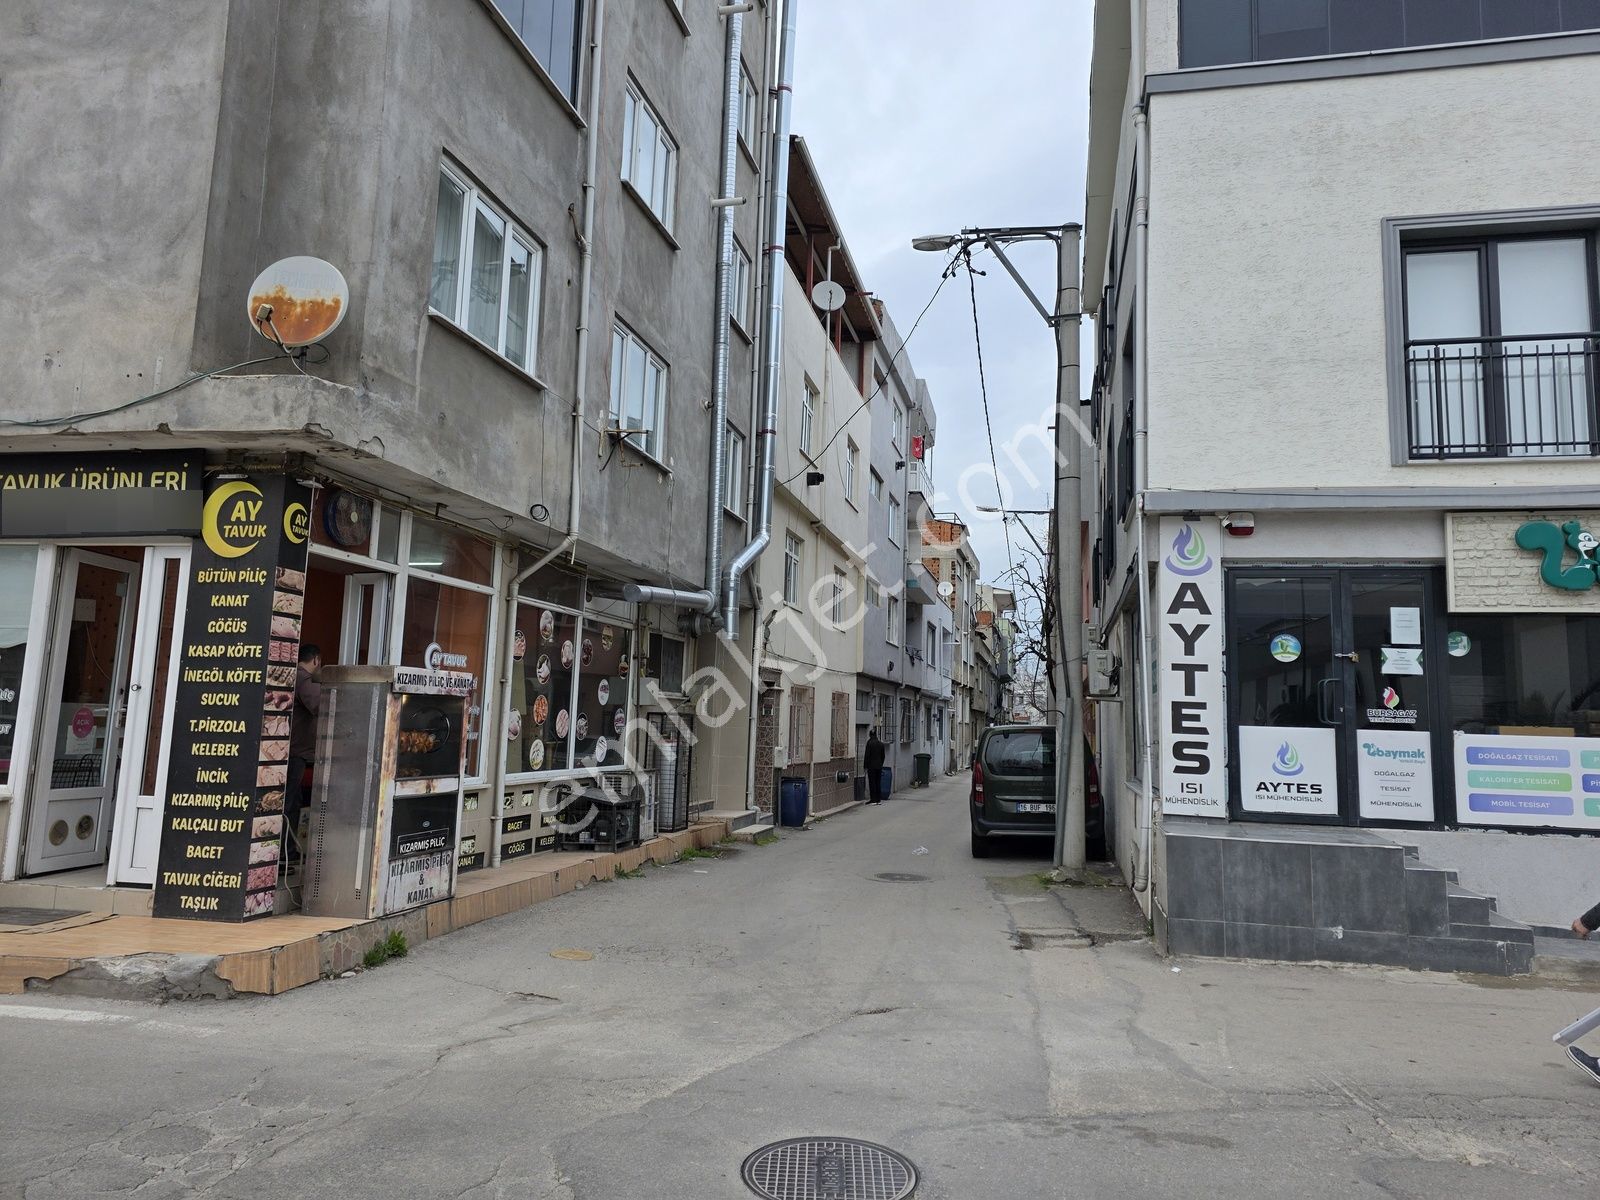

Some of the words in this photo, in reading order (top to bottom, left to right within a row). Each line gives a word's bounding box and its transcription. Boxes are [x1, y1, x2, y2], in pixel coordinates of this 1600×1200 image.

[0, 472, 65, 490] AVUK
[230, 500, 263, 522] AY
[294, 513, 308, 527] AY
[223, 525, 267, 538] TAVUK
[197, 568, 237, 583] BÜTÜN
[238, 567, 267, 586] PİLİÇ
[211, 595, 250, 607] KANAT
[207, 618, 247, 633] GÖĞÜS
[188, 645, 226, 658] KASAP
[226, 642, 262, 658] KÖFTE
[443, 653, 467, 667] TAVUK
[184, 667, 225, 683] İNEGÖL
[226, 667, 262, 683] KÖFTE
[1166, 582, 1212, 775] AYTES
[200, 693, 240, 706] SUCUK
[1367, 709, 1417, 718] BURSAGAZ
[189, 717, 246, 733] T.PİRZOLA
[191, 743, 240, 757] KELEBEK
[1376, 747, 1425, 760] baymak
[1478, 752, 1522, 761] DOĞALGAZ
[196, 767, 229, 784] İNCİK
[1180, 782, 1203, 794] ISI
[1255, 781, 1322, 794] AYTES
[171, 792, 222, 811] KIZARMIŞ
[222, 791, 250, 812] PİLİÇ
[1165, 795, 1219, 807] MÜHENDİSLİK
[1266, 794, 1323, 803] MÜHENDİSLİK
[1370, 800, 1423, 808] MÜHENDİSLİK
[1491, 799, 1517, 808] MOBİL
[1518, 801, 1551, 809] TESİSAT
[171, 817, 218, 834] KALÇALI
[220, 819, 244, 833] BUT
[507, 820, 523, 831] BAGET
[399, 839, 429, 854] KIZARMIŞ
[539, 836, 555, 846] KELEBE
[186, 845, 224, 859] BAGET
[163, 871, 201, 886] TAVUK
[202, 871, 242, 889] CİĞERİ
[418, 873, 425, 885] &
[407, 886, 434, 904] KANAT
[180, 895, 219, 912] TAŞLIK
